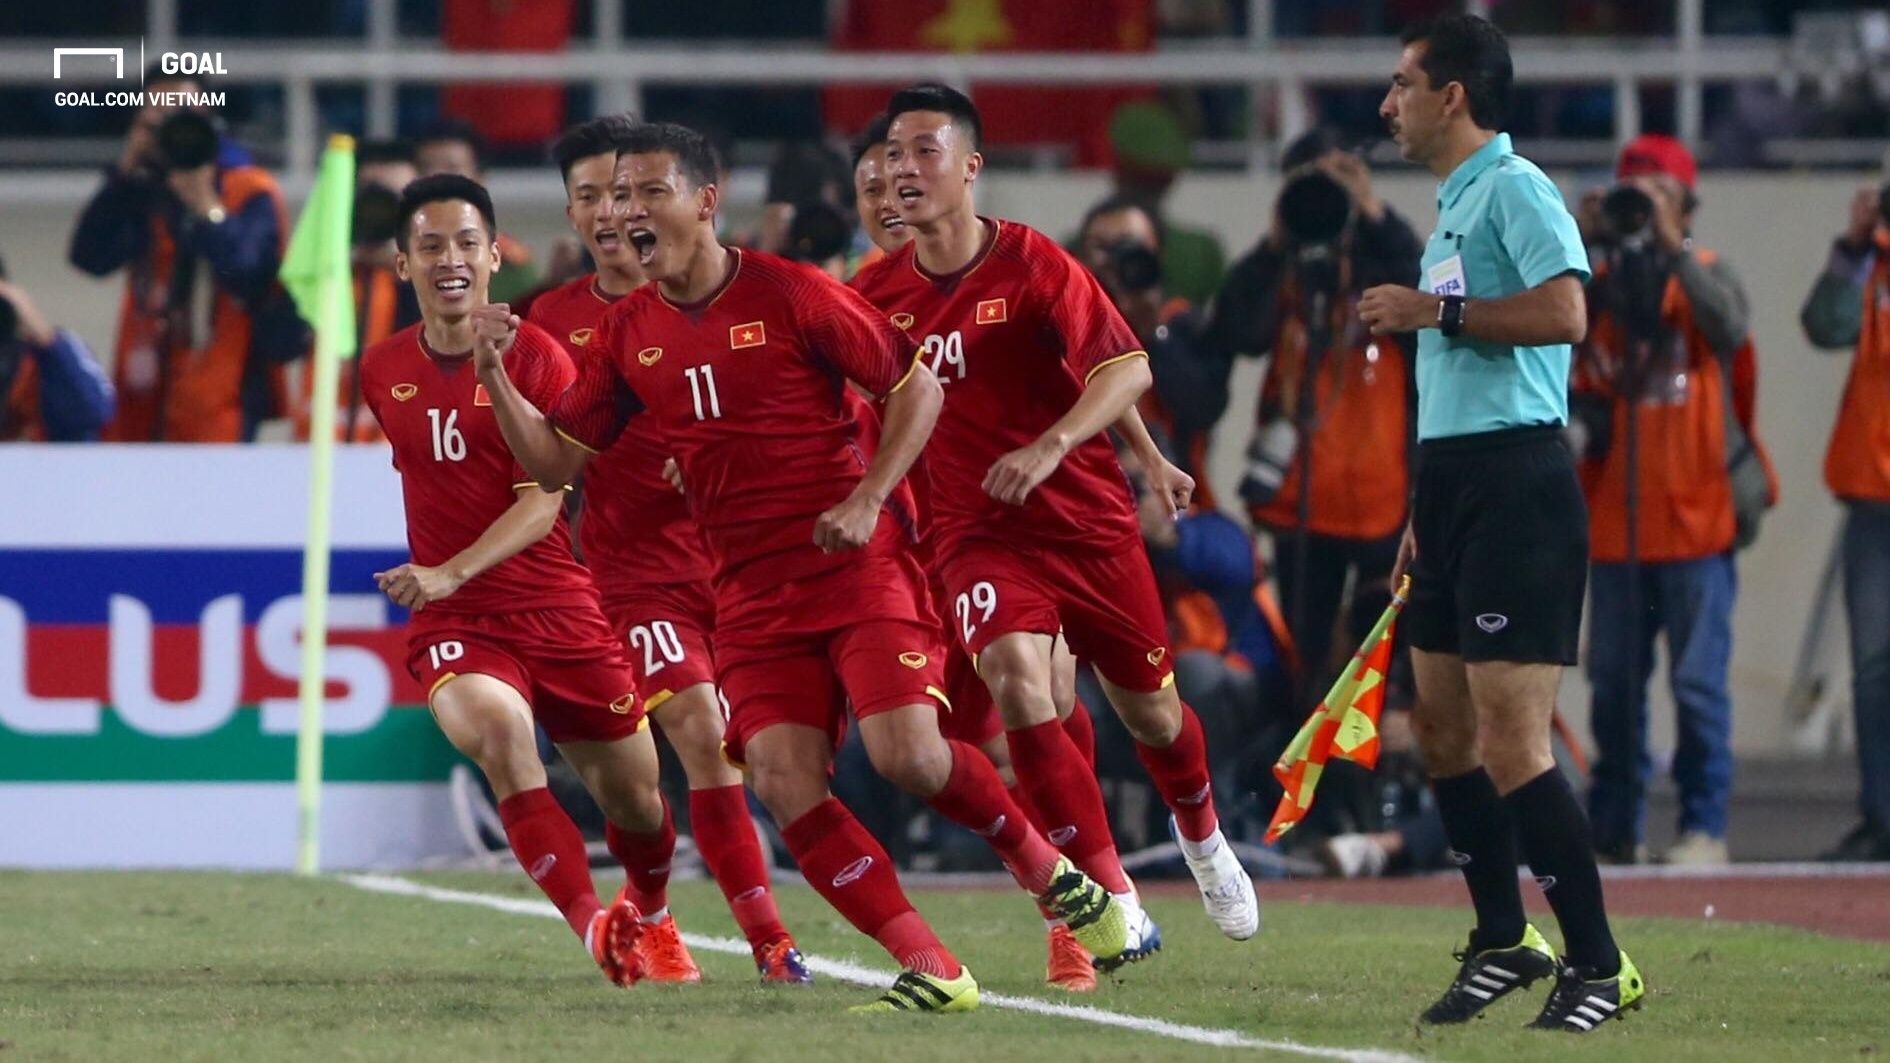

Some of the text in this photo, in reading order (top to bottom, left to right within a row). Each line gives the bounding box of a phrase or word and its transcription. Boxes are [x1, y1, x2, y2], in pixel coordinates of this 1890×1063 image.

[924, 330, 967, 384] 29
[684, 363, 722, 421] 11
[427, 408, 467, 462] 16
[955, 581, 997, 644] 29
[0, 593, 392, 738] LUS
[628, 620, 686, 677] 20
